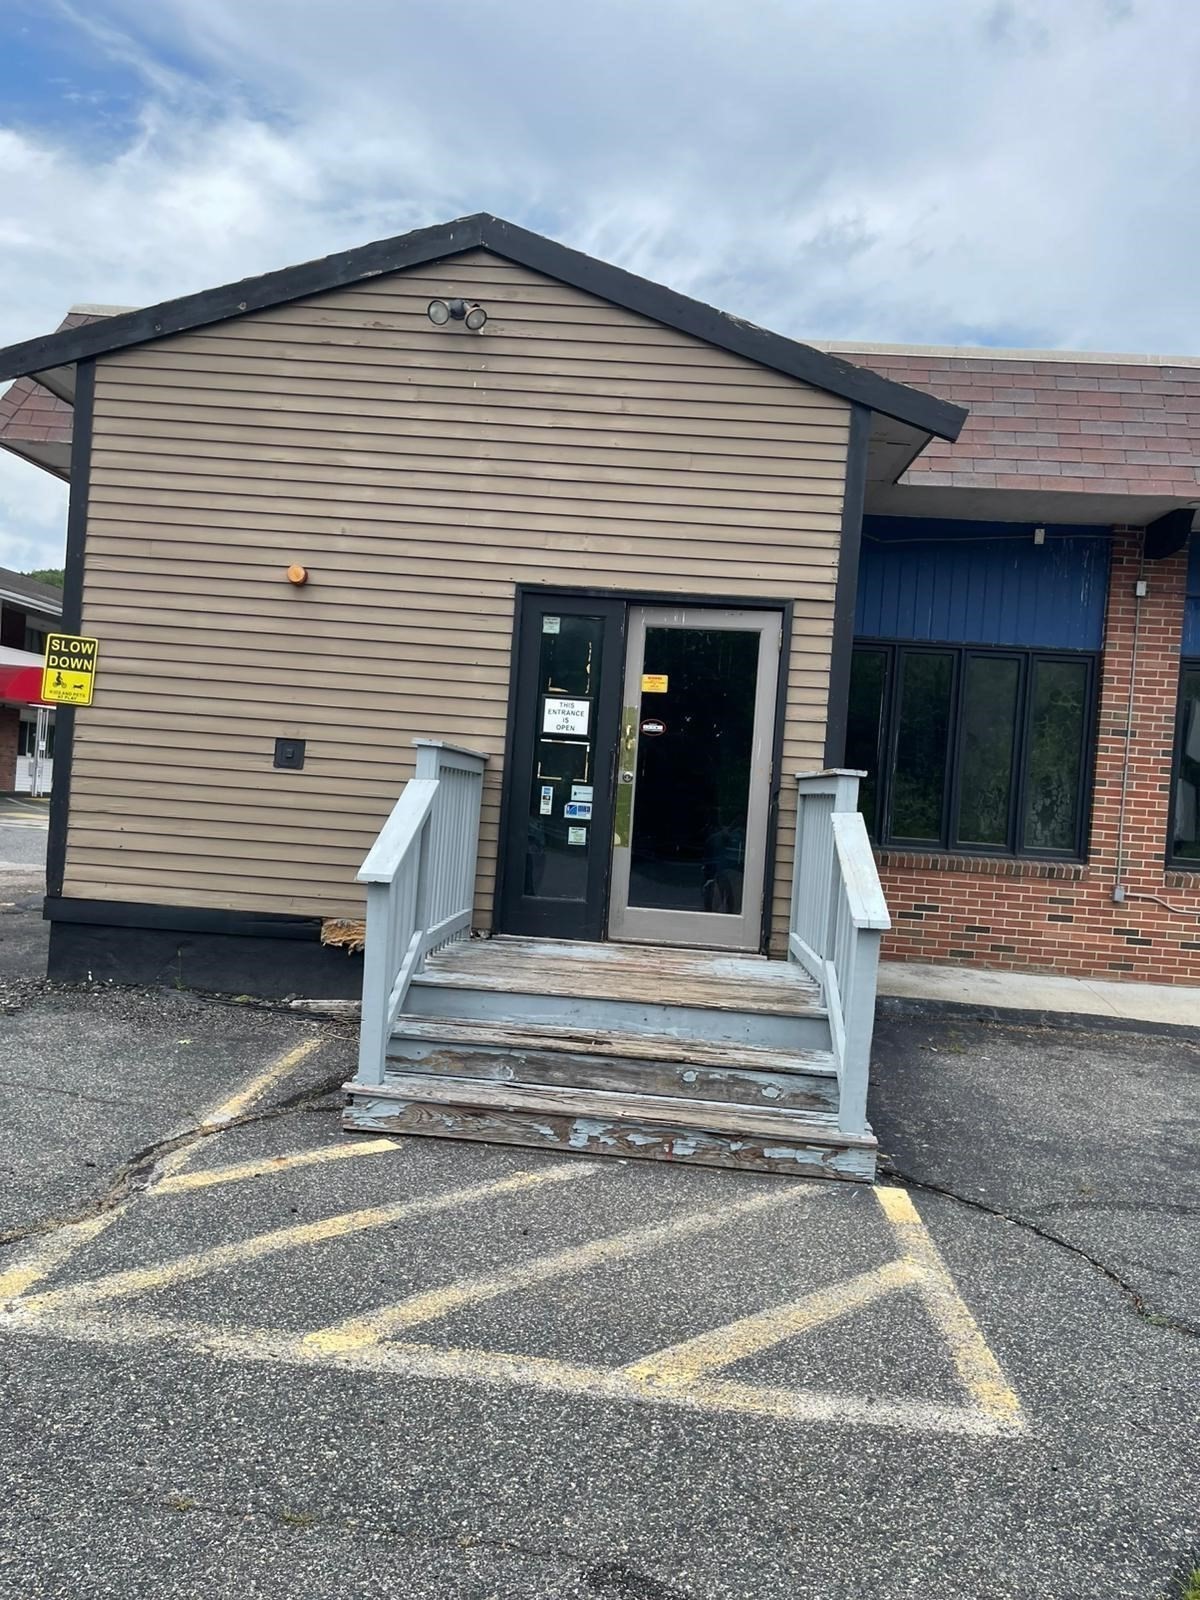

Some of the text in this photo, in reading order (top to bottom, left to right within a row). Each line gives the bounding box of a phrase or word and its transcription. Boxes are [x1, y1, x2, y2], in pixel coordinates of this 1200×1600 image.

[51, 639, 94, 654] SLOW
[49, 655, 92, 670] DOWN
[547, 709, 585, 717] ENTRANCE
